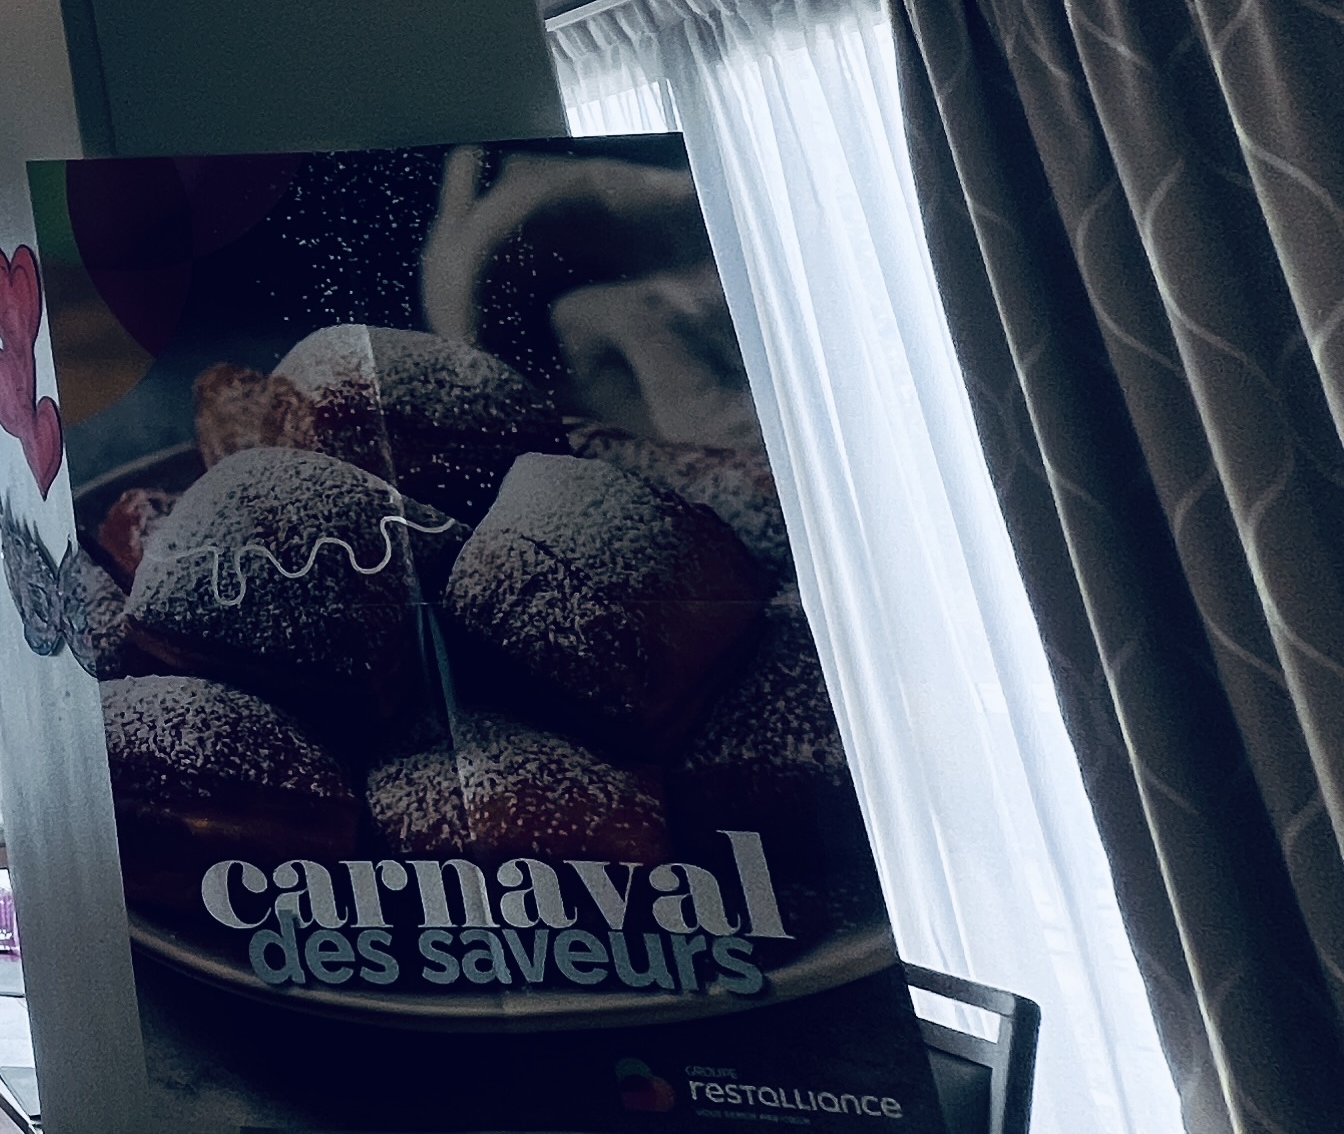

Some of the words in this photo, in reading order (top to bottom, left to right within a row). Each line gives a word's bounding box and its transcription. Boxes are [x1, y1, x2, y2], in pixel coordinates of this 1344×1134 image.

[201, 830, 796, 939] carnaval
[249, 909, 399, 985] des
[418, 928, 763, 995] saveurs
